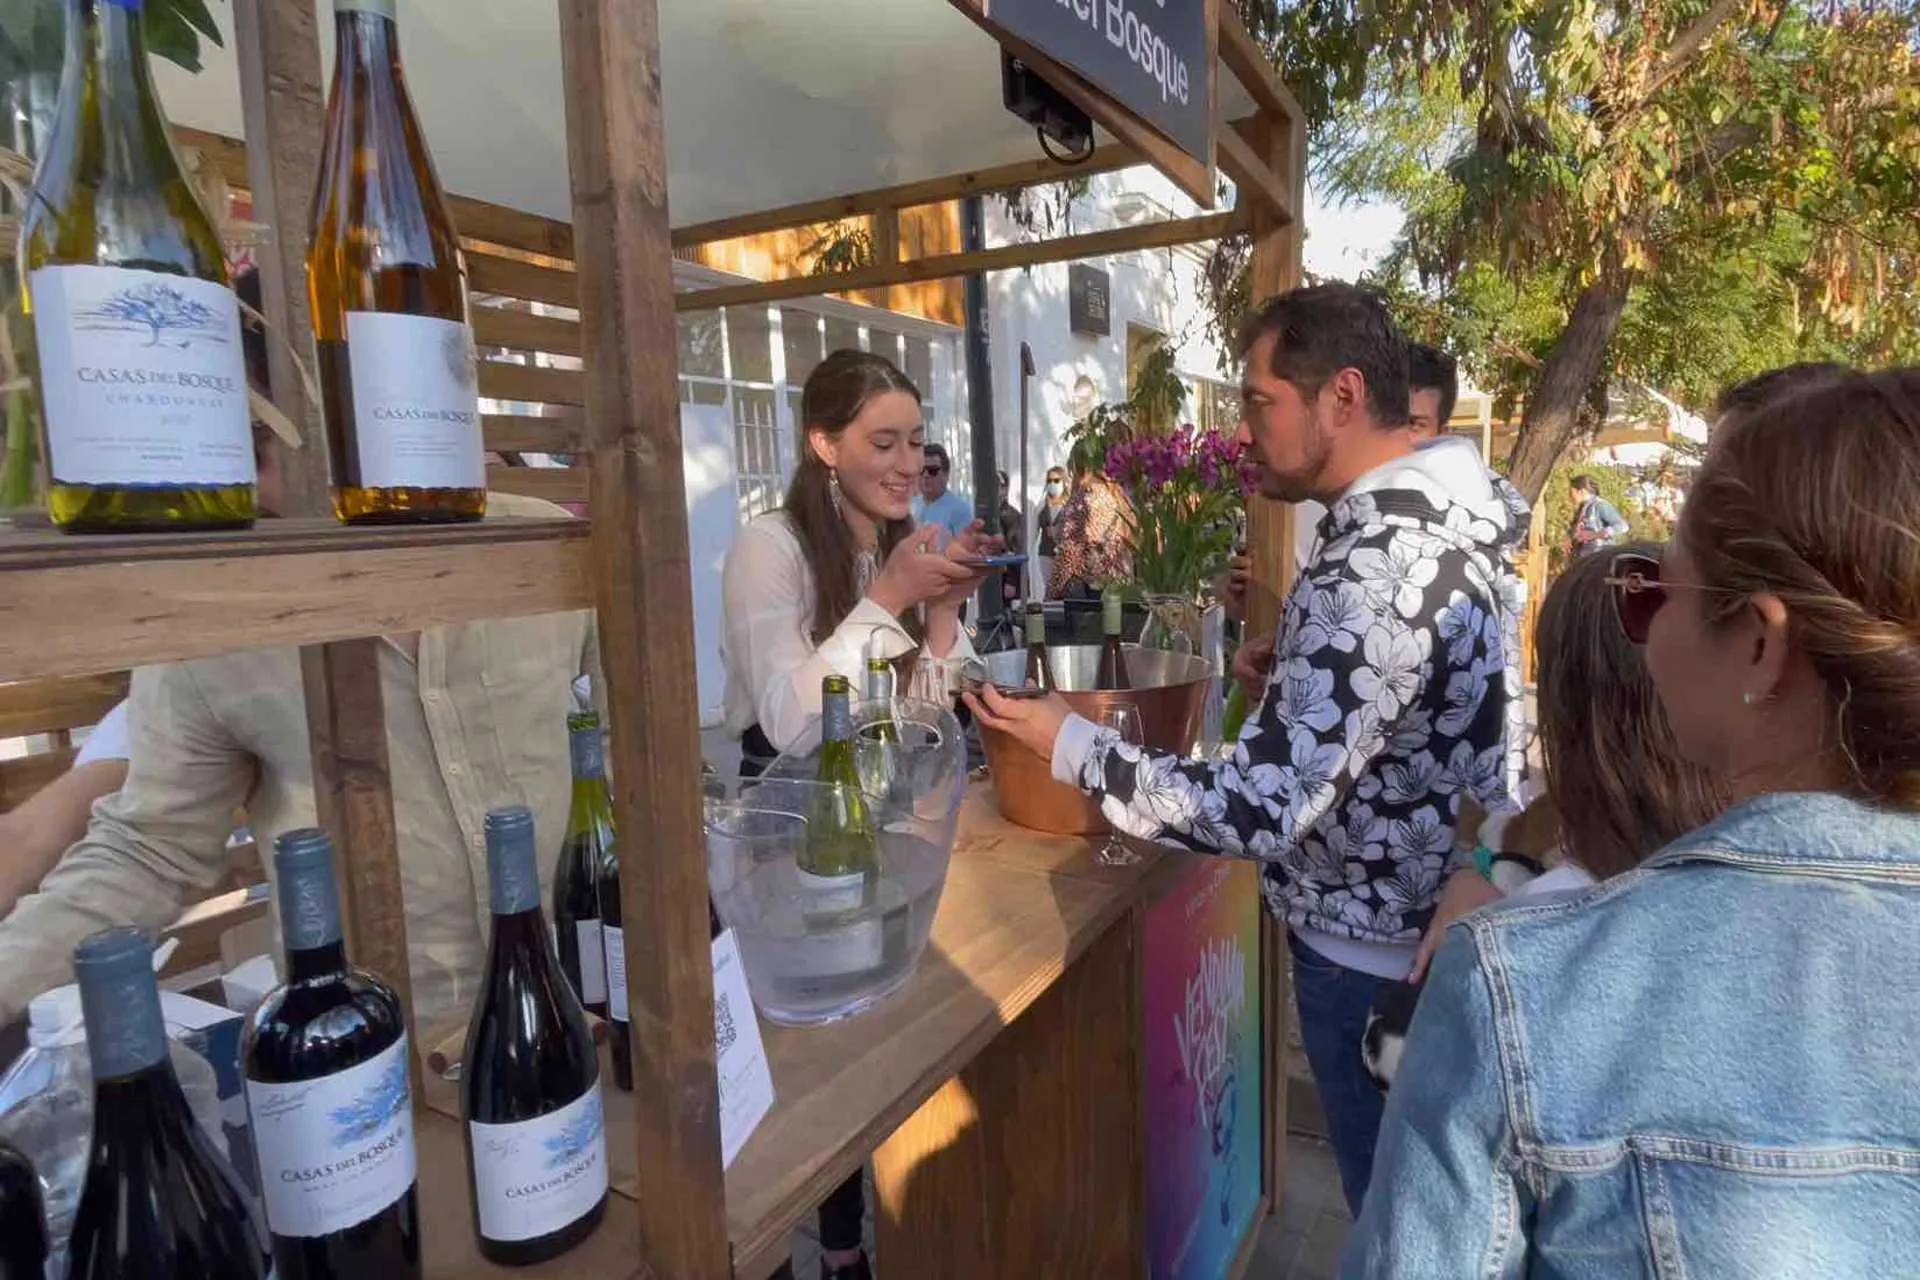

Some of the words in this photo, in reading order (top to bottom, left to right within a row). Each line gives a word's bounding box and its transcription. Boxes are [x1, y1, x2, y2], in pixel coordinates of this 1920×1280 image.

[1105, 0, 1189, 105] Bosque
[77, 366, 147, 384] CASAS
[177, 372, 238, 394] BOSQUE
[372, 405, 421, 420] CASAS
[280, 1164, 334, 1183] CASAS
[505, 1183, 546, 1198] CASAS
